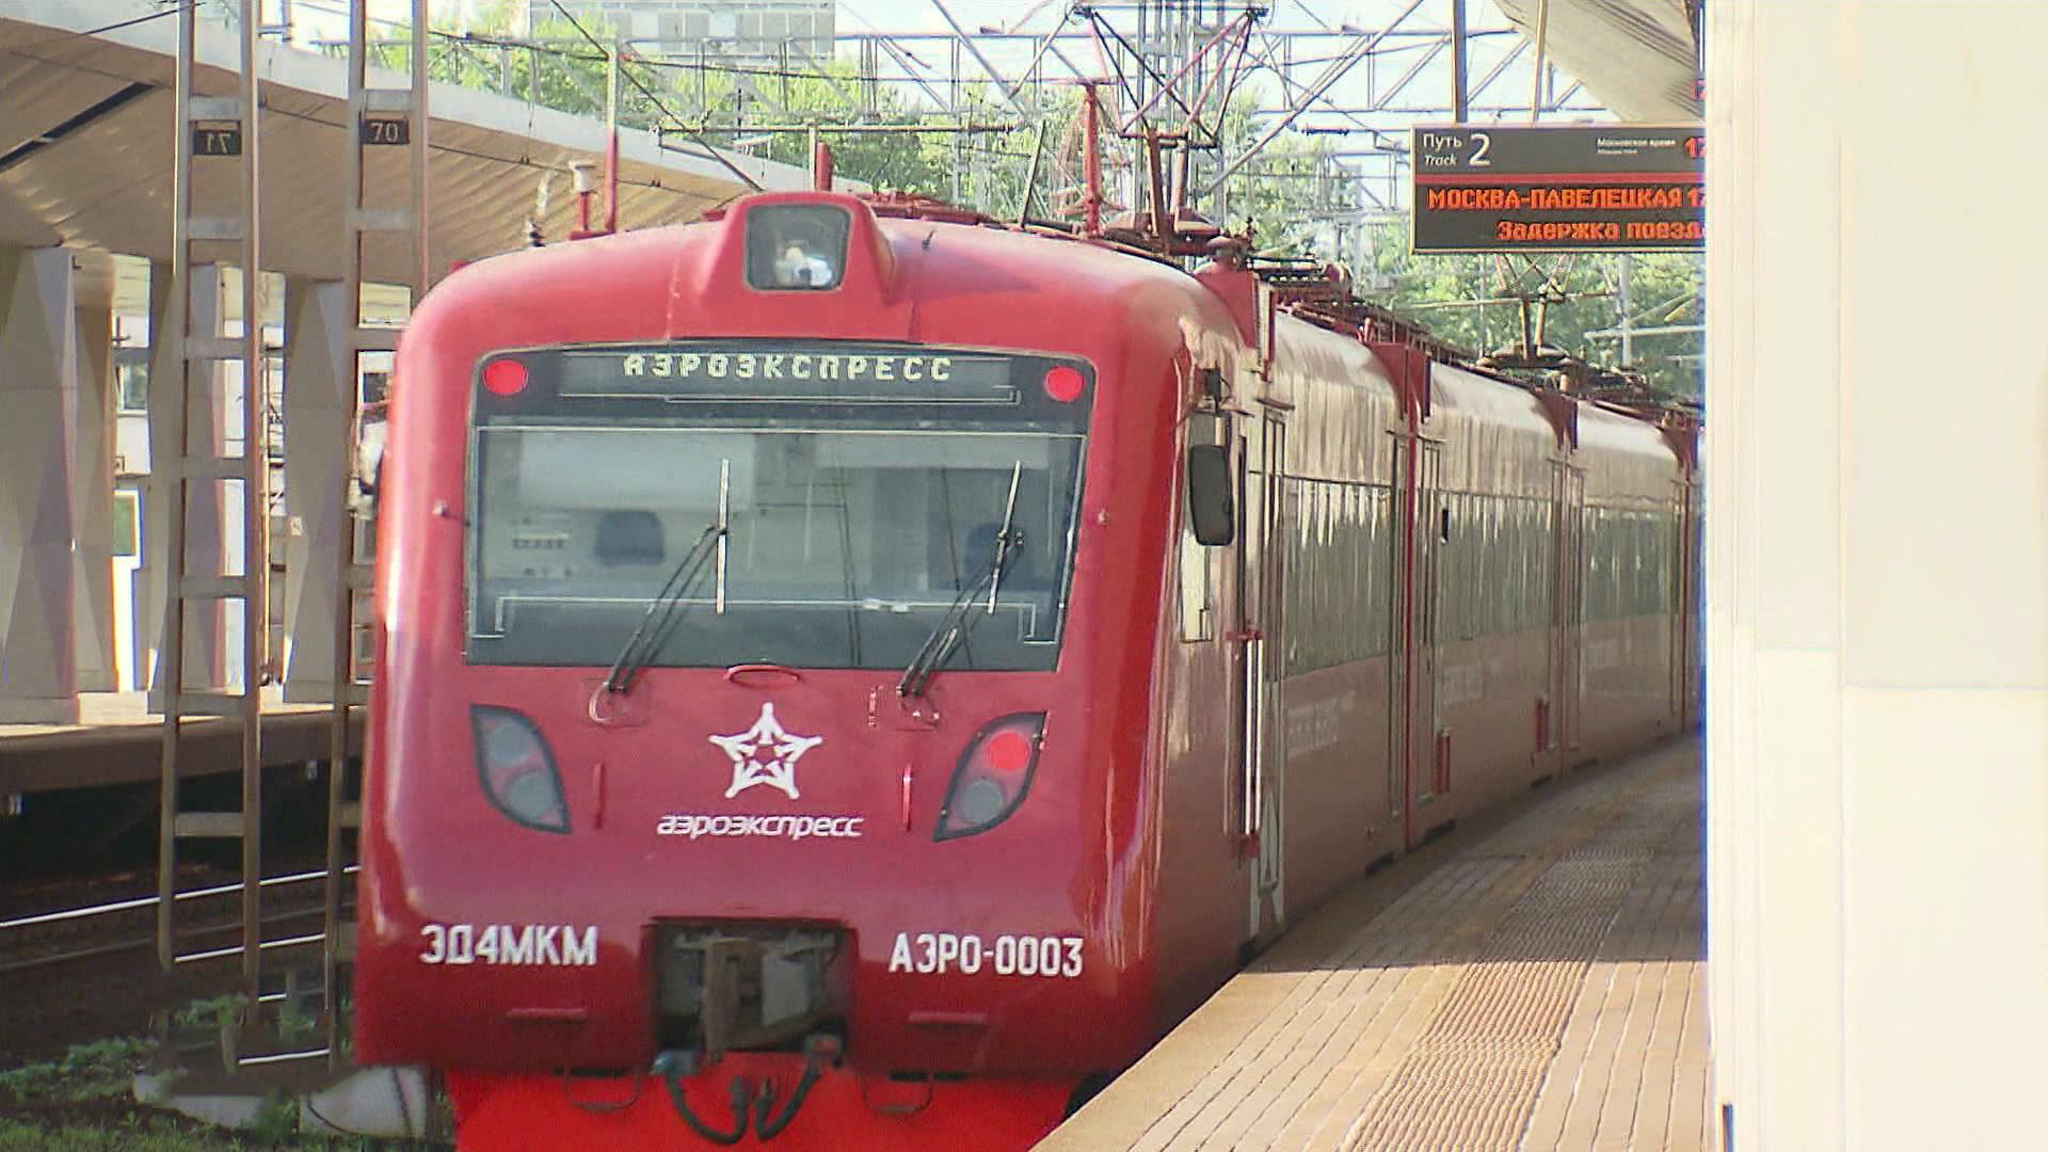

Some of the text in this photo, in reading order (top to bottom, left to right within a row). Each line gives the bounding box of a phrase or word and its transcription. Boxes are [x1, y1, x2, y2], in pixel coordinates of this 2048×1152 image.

[370, 122, 399, 142] 70
[1423, 133, 1491, 166] Путь 2
[1425, 153, 1457, 167] Track
[1428, 188, 1682, 210] МОСКВА-ПАВЕЛЕЦКАЯ
[1496, 221, 1620, 240] Задержка
[623, 353, 952, 381] АЭРОЭКСПРЕСС
[656, 815, 865, 841] аэроэкспресс
[419, 923, 598, 966] ЭД4МКМ
[888, 932, 1085, 977] АЭРО-0003
